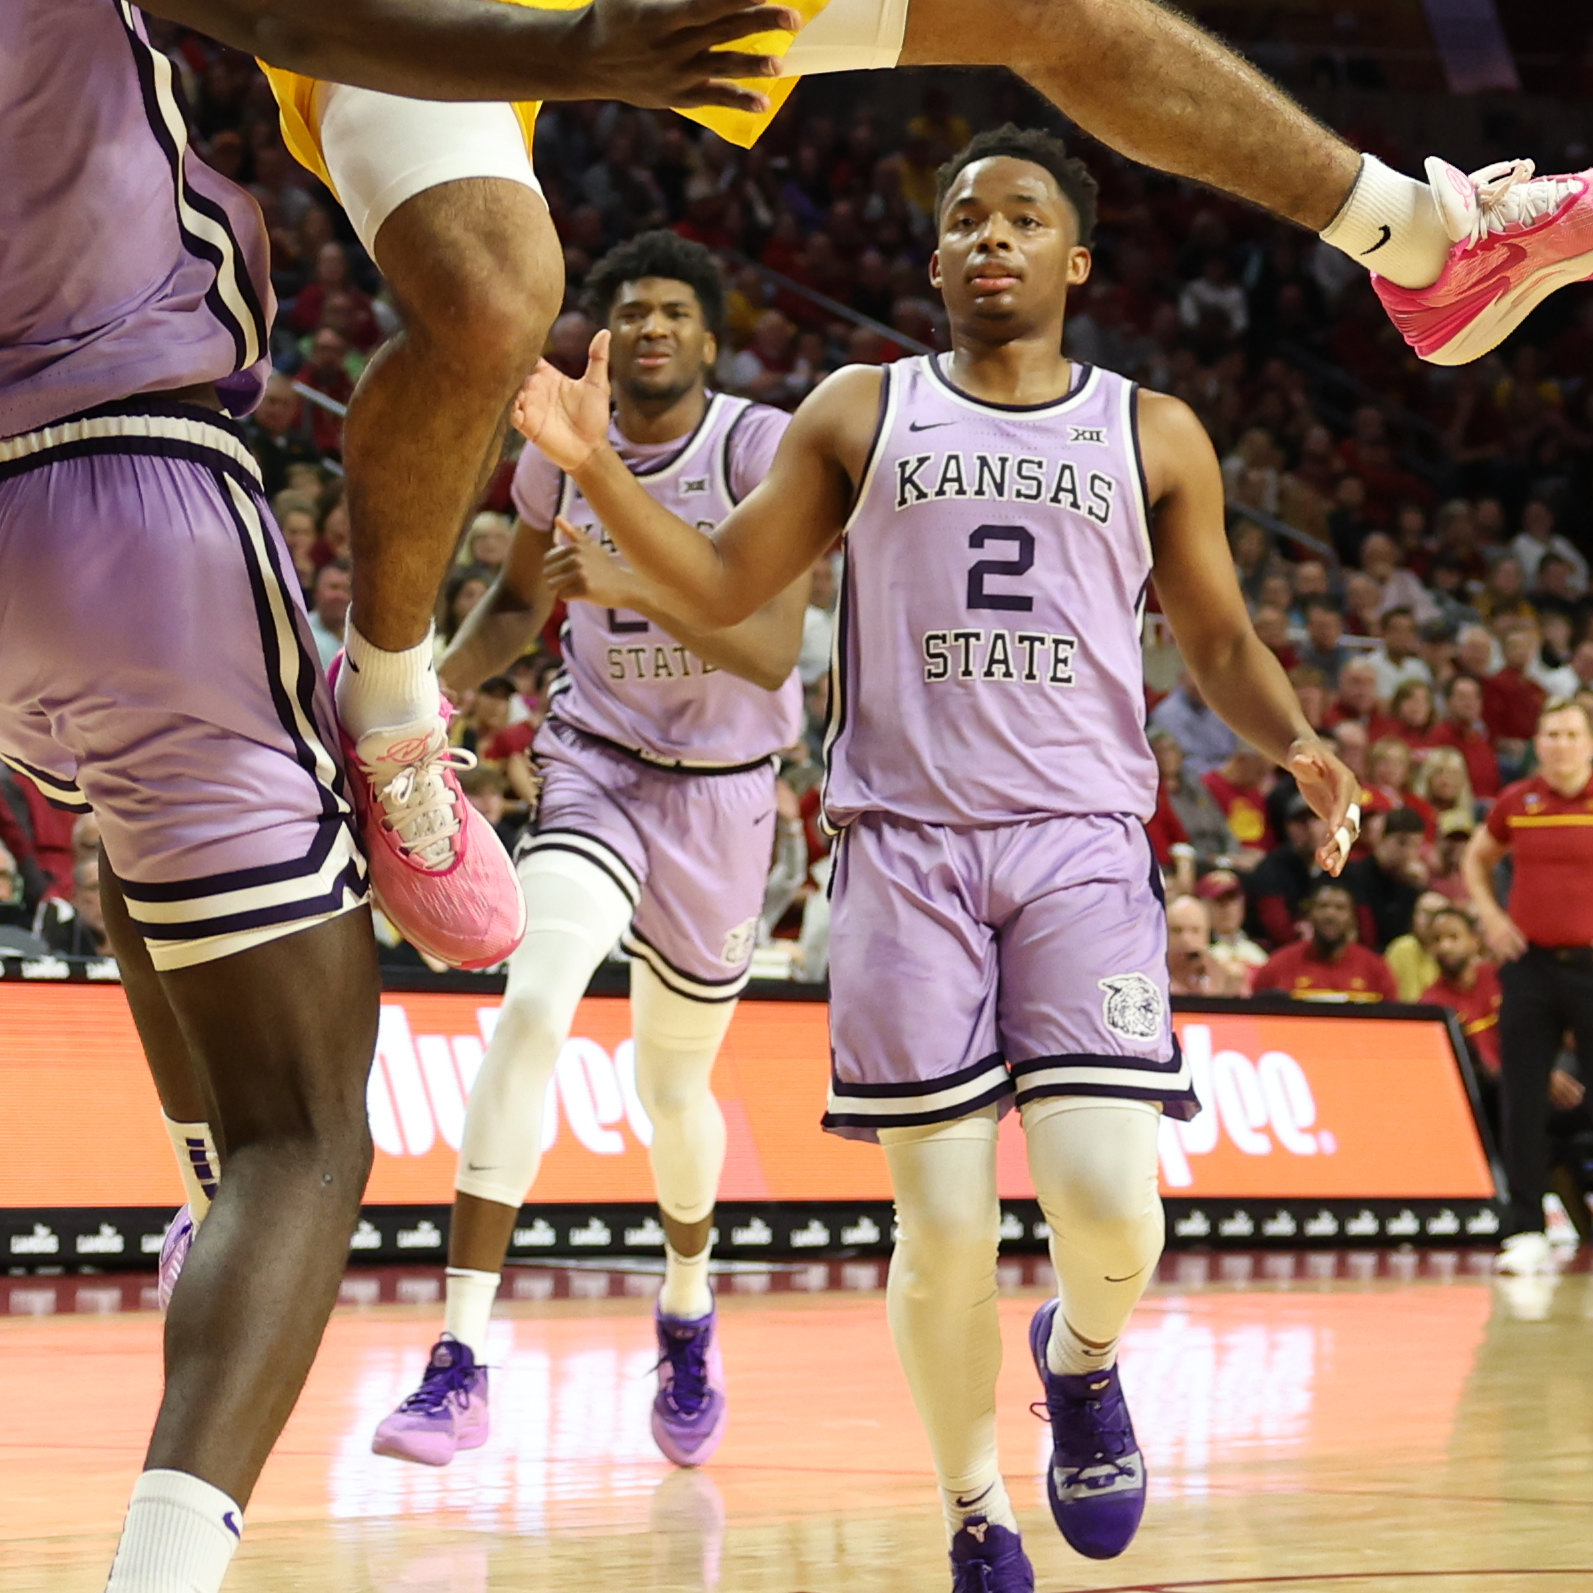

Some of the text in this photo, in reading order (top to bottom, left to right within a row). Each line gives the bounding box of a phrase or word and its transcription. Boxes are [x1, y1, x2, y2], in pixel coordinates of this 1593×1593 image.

[894, 451, 1118, 527] KANSAS
[966, 523, 1036, 612] 2
[923, 629, 1078, 687] STATE
